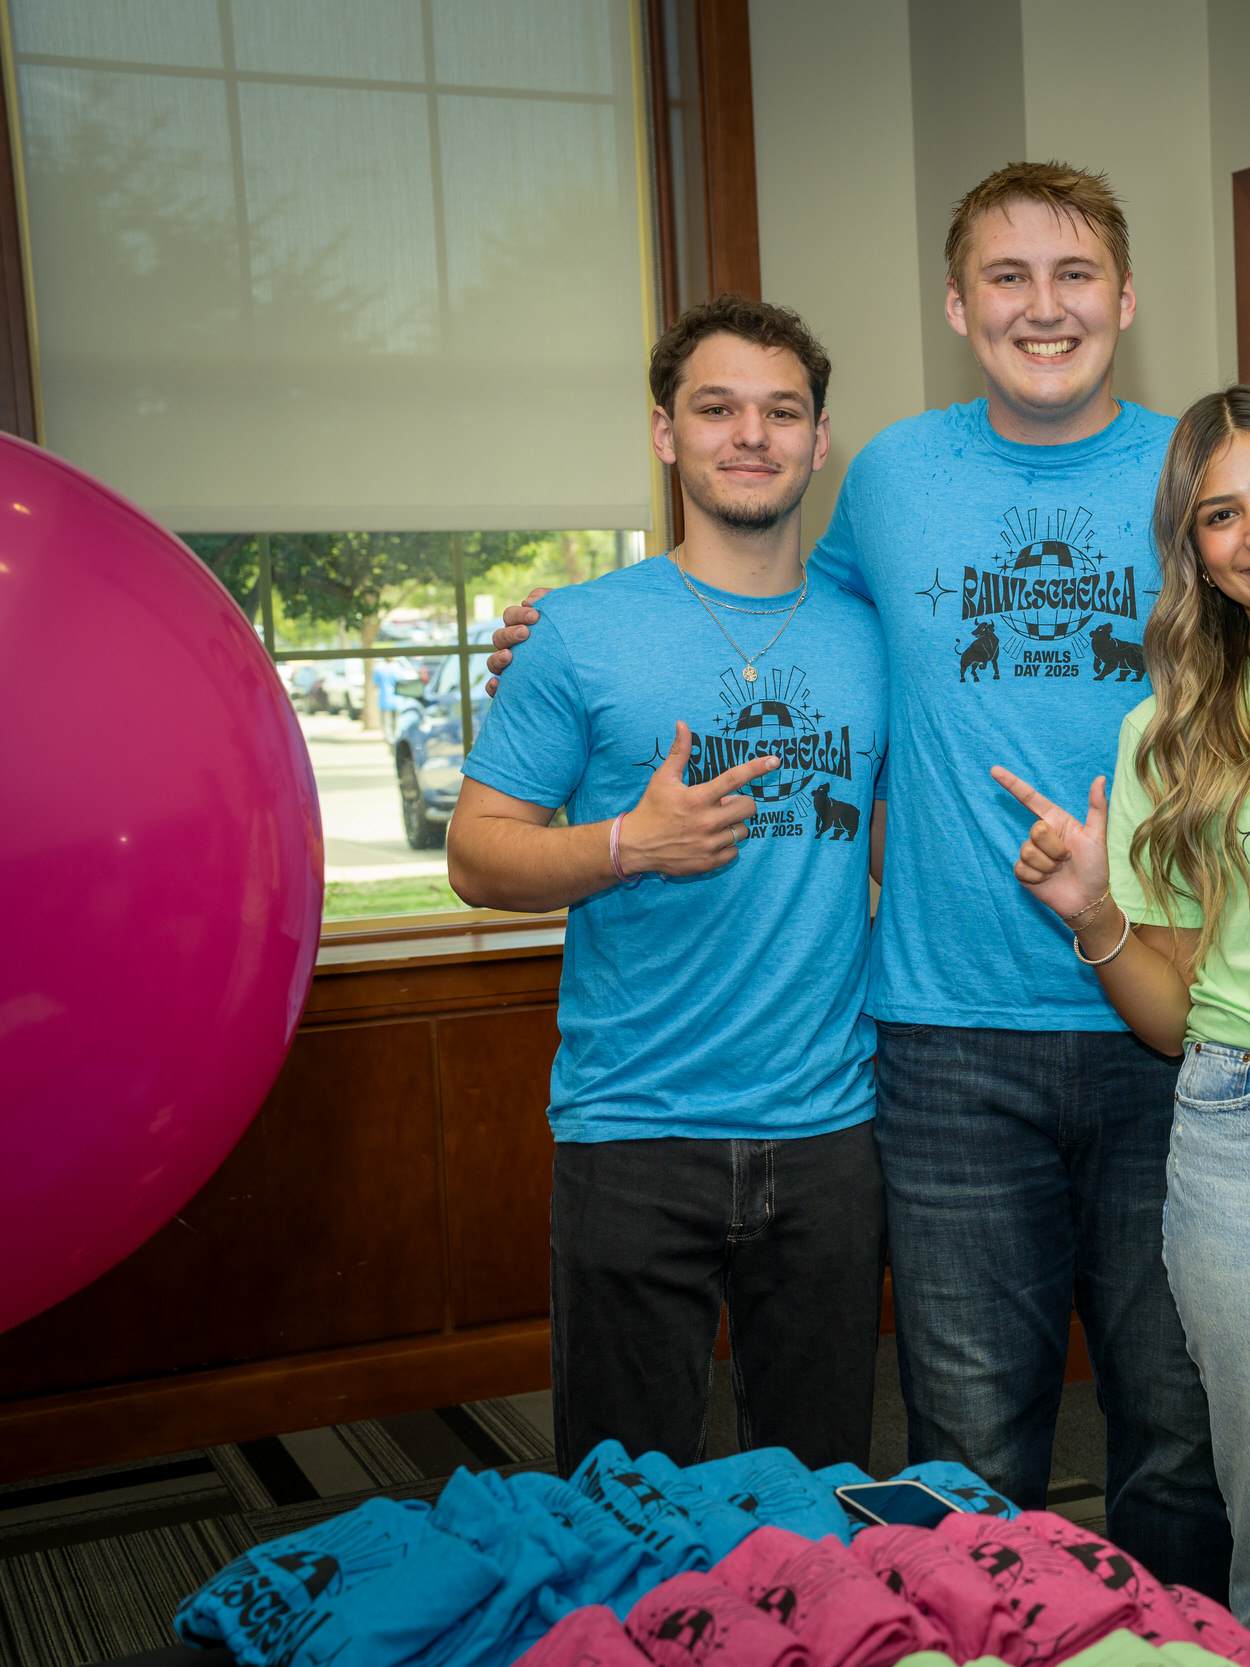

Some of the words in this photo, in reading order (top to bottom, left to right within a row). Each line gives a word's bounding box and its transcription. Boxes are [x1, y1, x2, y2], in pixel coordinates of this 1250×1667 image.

[962, 565, 1137, 620] RAWLSCHELLA
[1023, 651, 1071, 663] RAWLS
[1014, 665, 1039, 677] DAY
[1044, 665, 1079, 677] 2025
[750, 810, 795, 825] RAWLS
[772, 824, 803, 837] 2025
